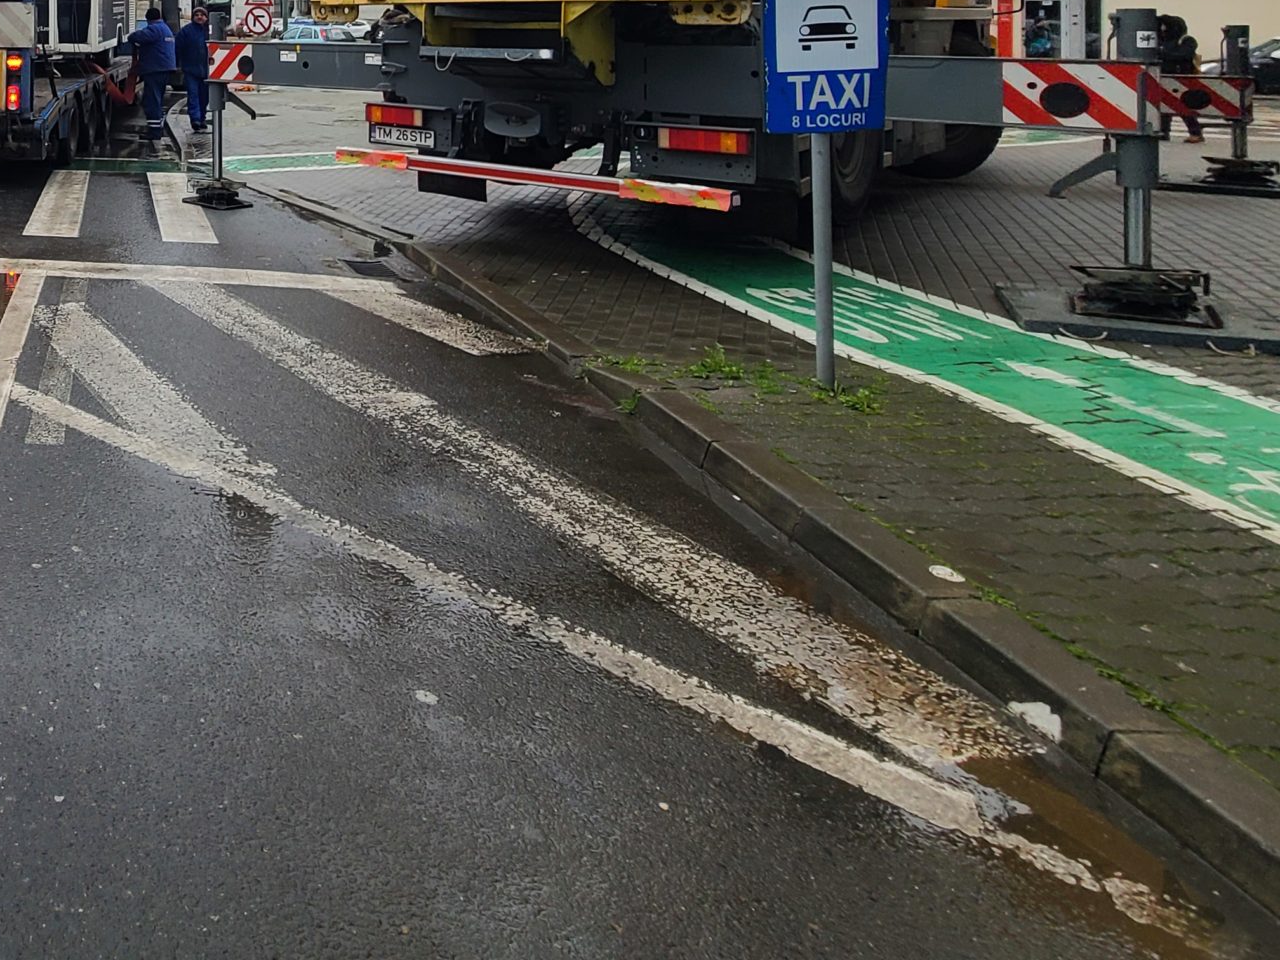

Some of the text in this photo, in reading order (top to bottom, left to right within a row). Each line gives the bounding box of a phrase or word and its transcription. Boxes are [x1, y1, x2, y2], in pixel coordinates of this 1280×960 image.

[787, 73, 871, 111] TAXI
[792, 113, 865, 128] 8 LOCURI
[377, 127, 392, 139] TM
